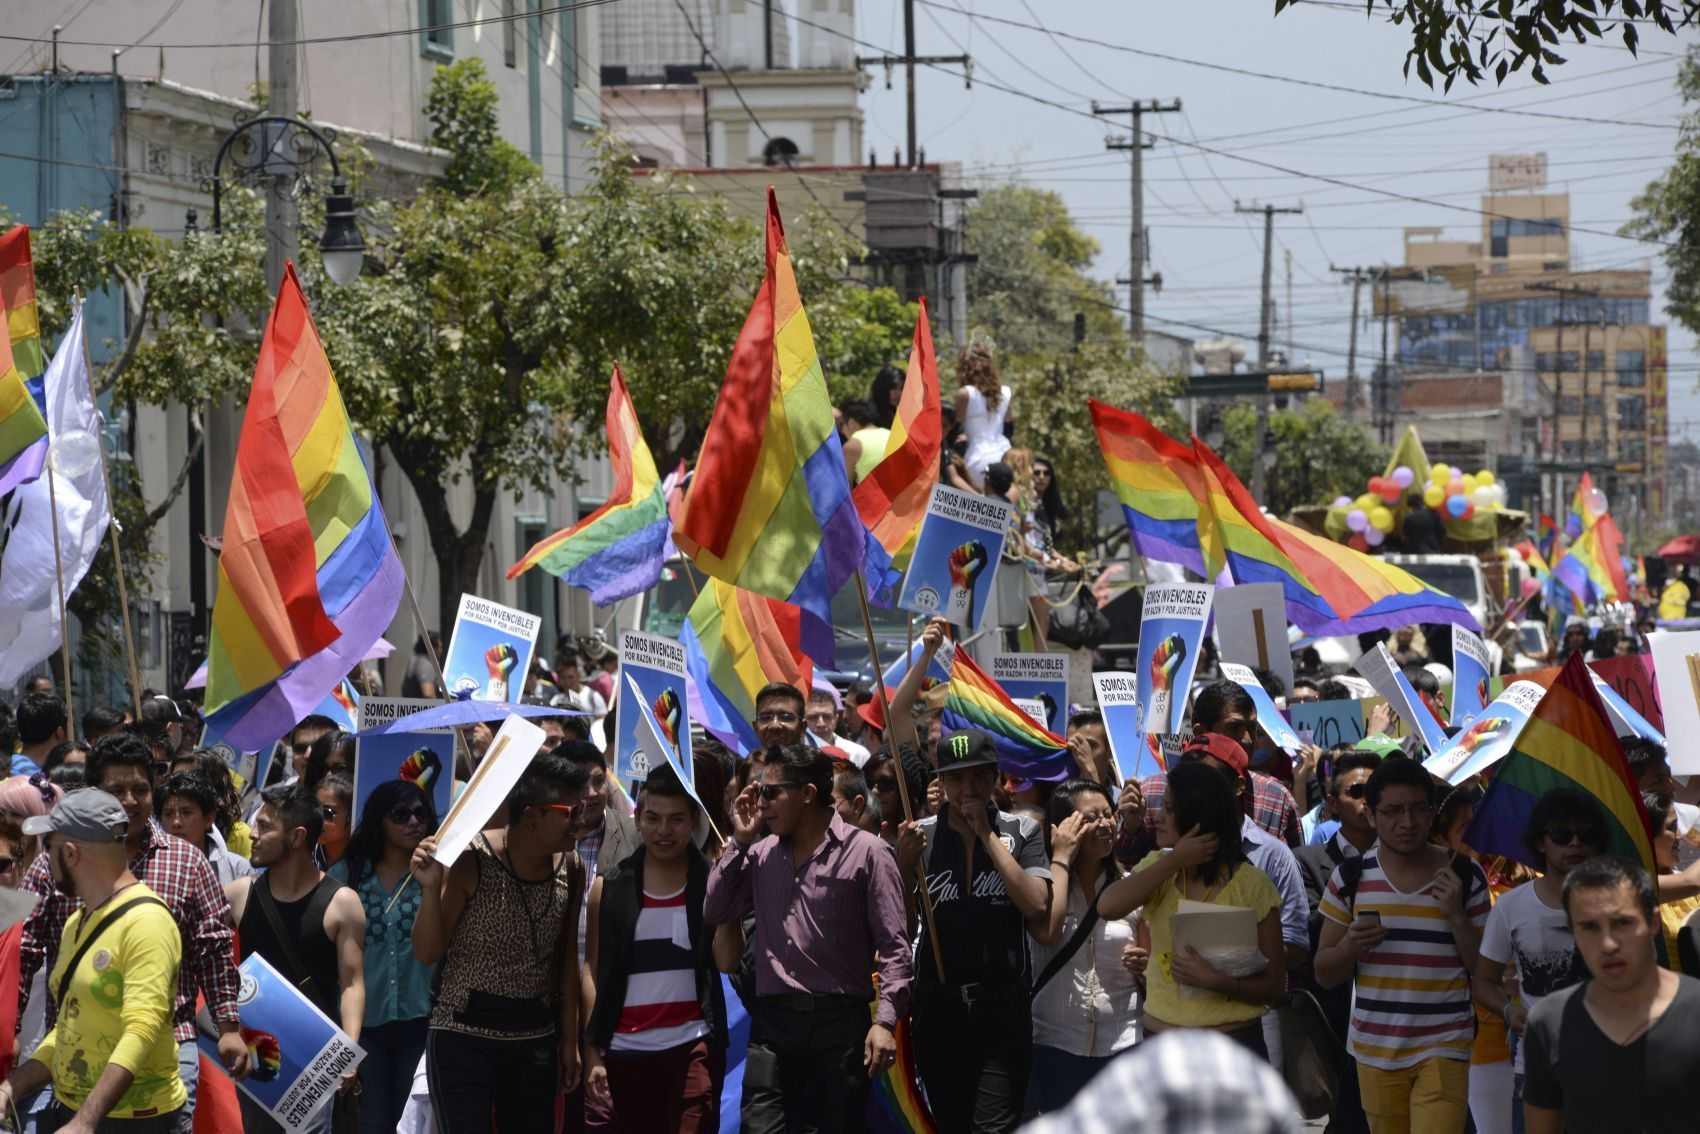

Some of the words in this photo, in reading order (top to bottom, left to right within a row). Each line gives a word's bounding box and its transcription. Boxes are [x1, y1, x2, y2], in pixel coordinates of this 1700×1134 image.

[932, 503, 942, 511] POR
[960, 511, 966, 519] Y
[966, 513, 977, 522] POR
[935, 489, 959, 507] SOMOS
[959, 497, 1007, 520] INVENCIBLES
[1146, 590, 1161, 605] SOMOS
[1161, 589, 1207, 605] INVENCIBLES
[466, 600, 490, 615] SOMOS
[491, 607, 535, 631] INVENCIBLES
[1165, 605, 1176, 614] POR
[464, 610, 475, 618] POR
[497, 621, 508, 629] POR
[1456, 629, 1471, 646] SOMOS
[625, 635, 648, 652] SOMOS
[649, 640, 683, 663] INVENCIBLES
[625, 651, 635, 661] POR
[657, 658, 666, 668] POR
[994, 657, 1018, 669] SOMOS
[1020, 658, 1064, 670] INVENCIBLES
[1100, 678, 1127, 692] SOMOS
[1104, 693, 1117, 702] POR
[364, 703, 395, 718] SOMOS
[364, 718, 377, 727] POR
[329, 1038, 343, 1053] POR
[326, 1047, 356, 1079] SOMOS
[297, 1075, 311, 1090] POR
[308, 1071, 315, 1079] Y
[286, 1074, 333, 1128] INVENCIBLES
